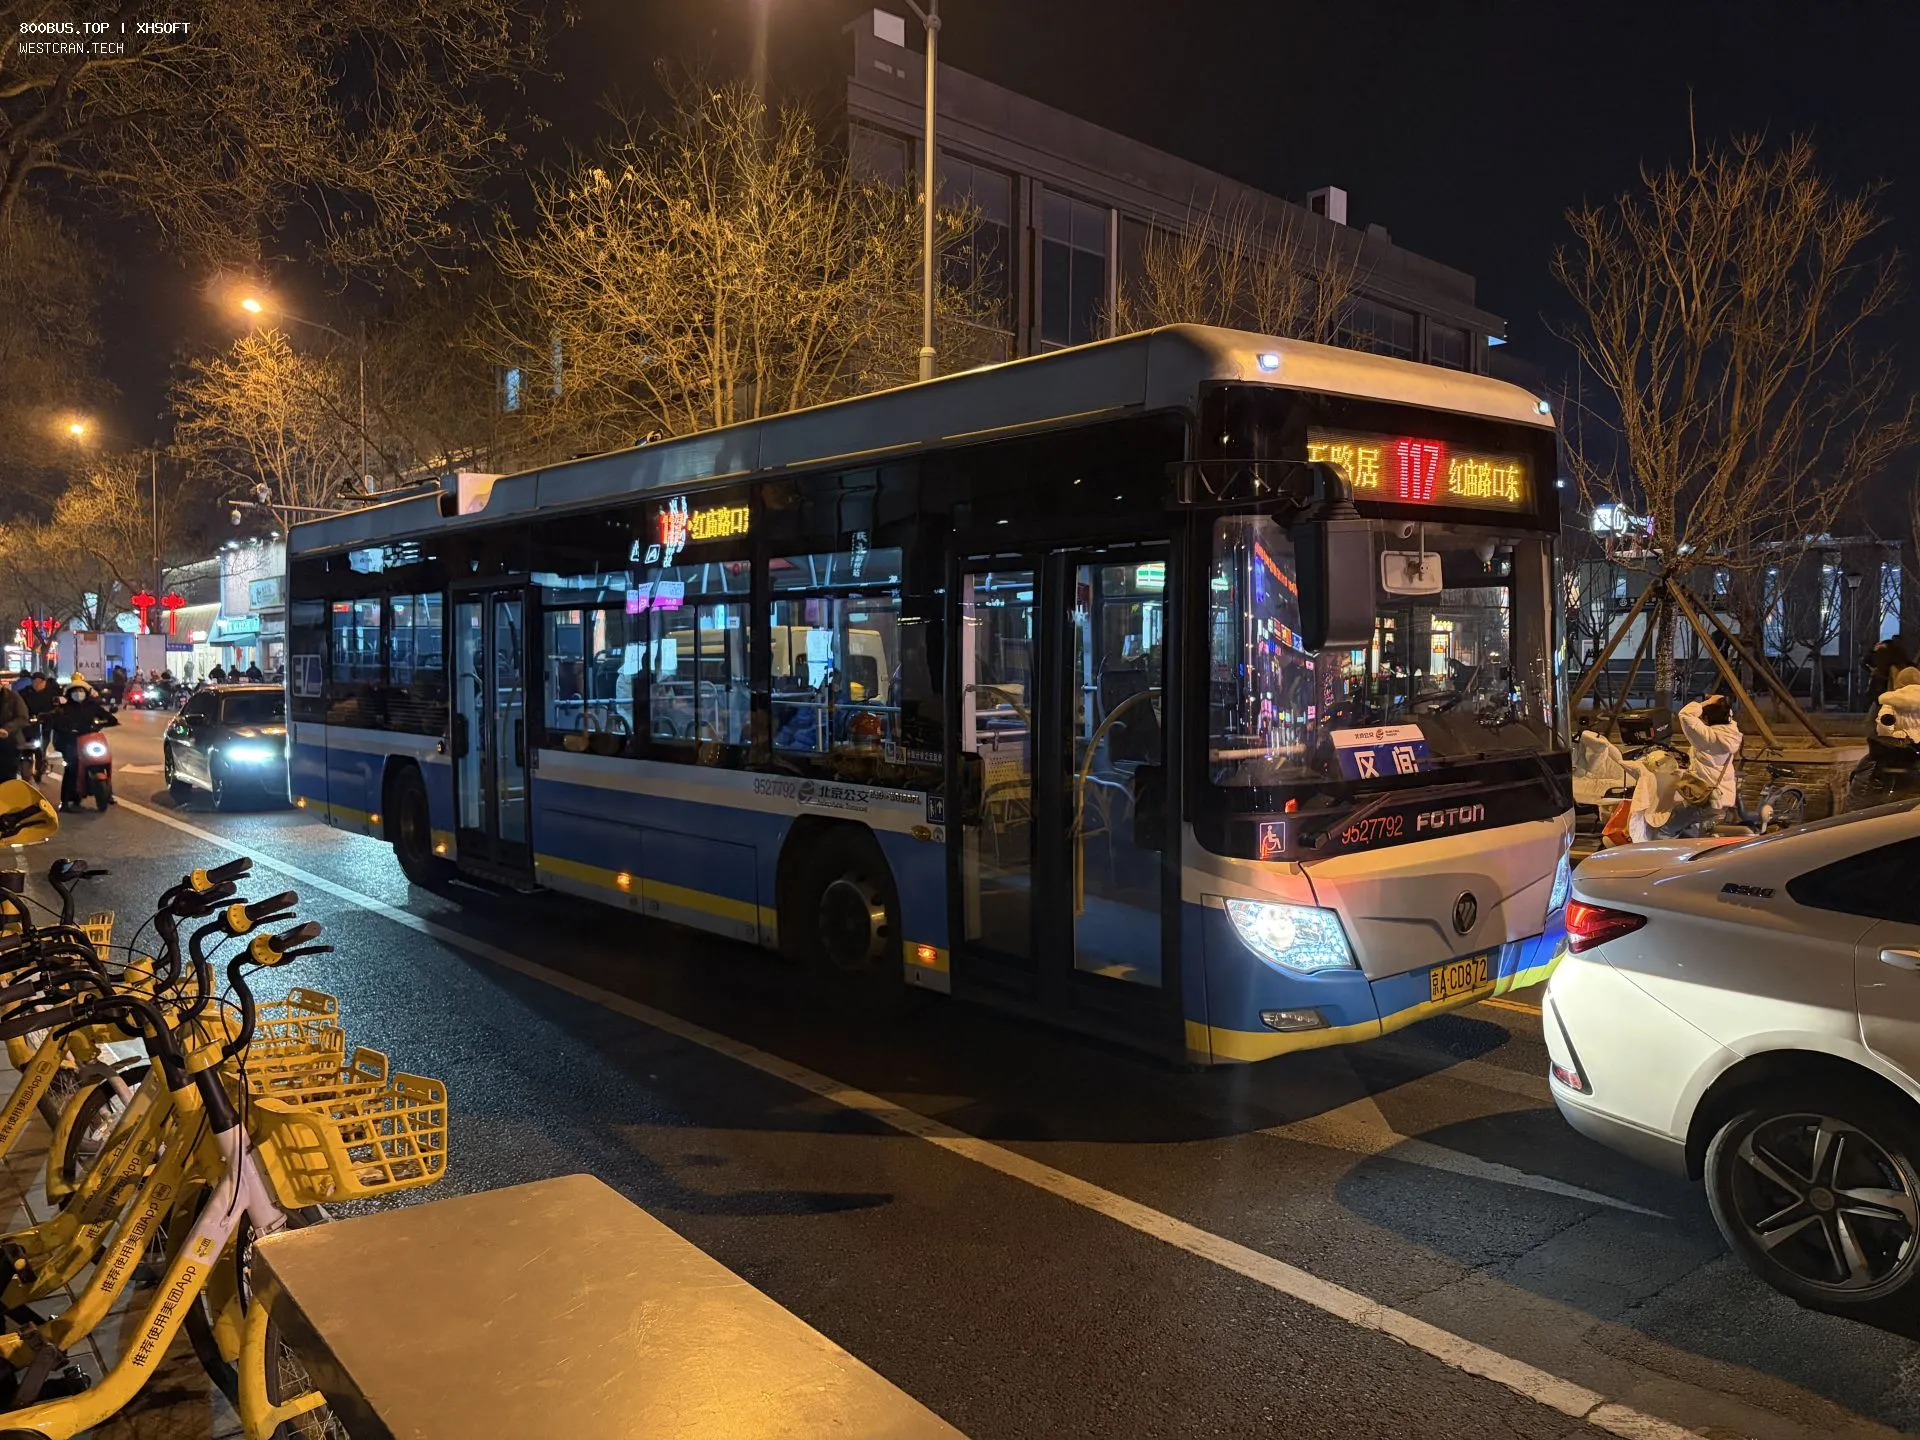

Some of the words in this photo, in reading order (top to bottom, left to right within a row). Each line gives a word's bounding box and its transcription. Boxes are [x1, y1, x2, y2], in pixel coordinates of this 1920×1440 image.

[1397, 441, 1439, 500] 117
[1449, 458, 1520, 502] 红庙路口东
[1354, 745, 1420, 779] 区间
[754, 778, 796, 799] 9527792
[820, 786, 870, 803] 北京公交
[1341, 815, 1404, 845] 9527792
[1416, 804, 1485, 832] FOTON
[101, 1202, 159, 1293] 推荐使用美团App
[132, 1265, 197, 1367] 推荐使用美团App
